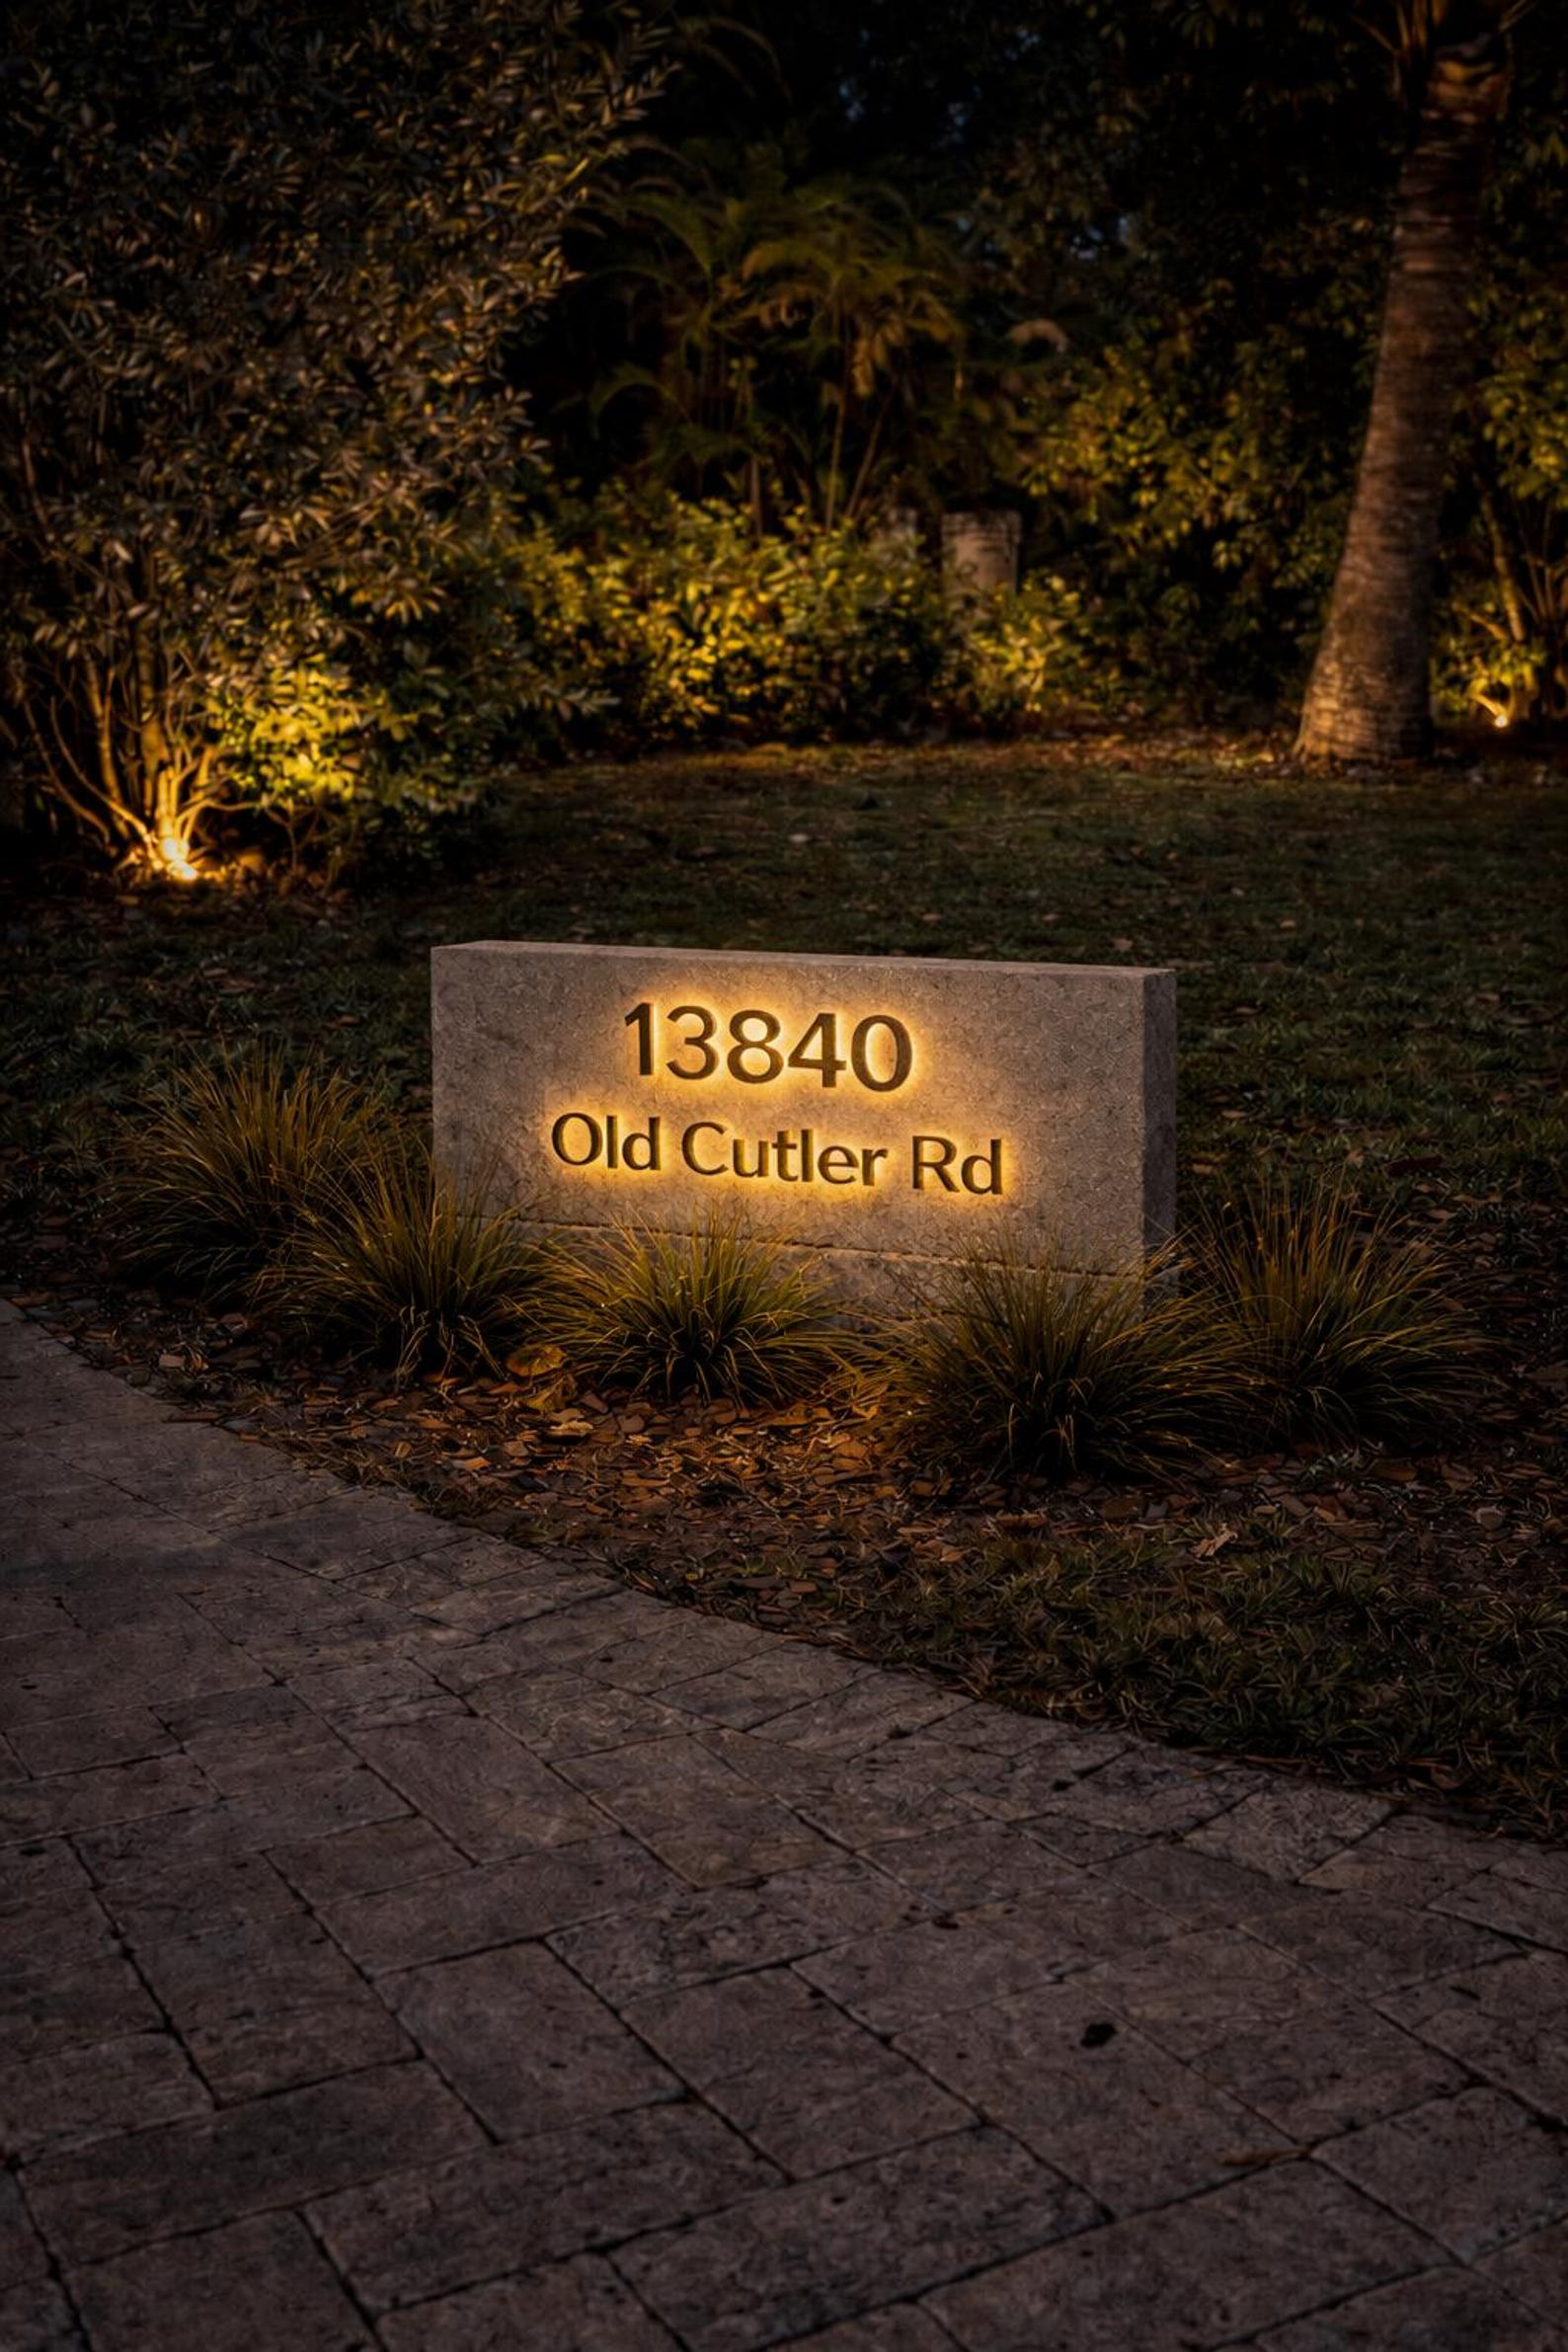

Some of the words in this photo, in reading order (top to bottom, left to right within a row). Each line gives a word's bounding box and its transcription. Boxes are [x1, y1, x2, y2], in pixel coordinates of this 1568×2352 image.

[624, 1002, 913, 1092] 13840
[551, 1112, 662, 1171] Old
[680, 1121, 888, 1186] Cutler
[911, 1136, 1003, 1195] Rd
